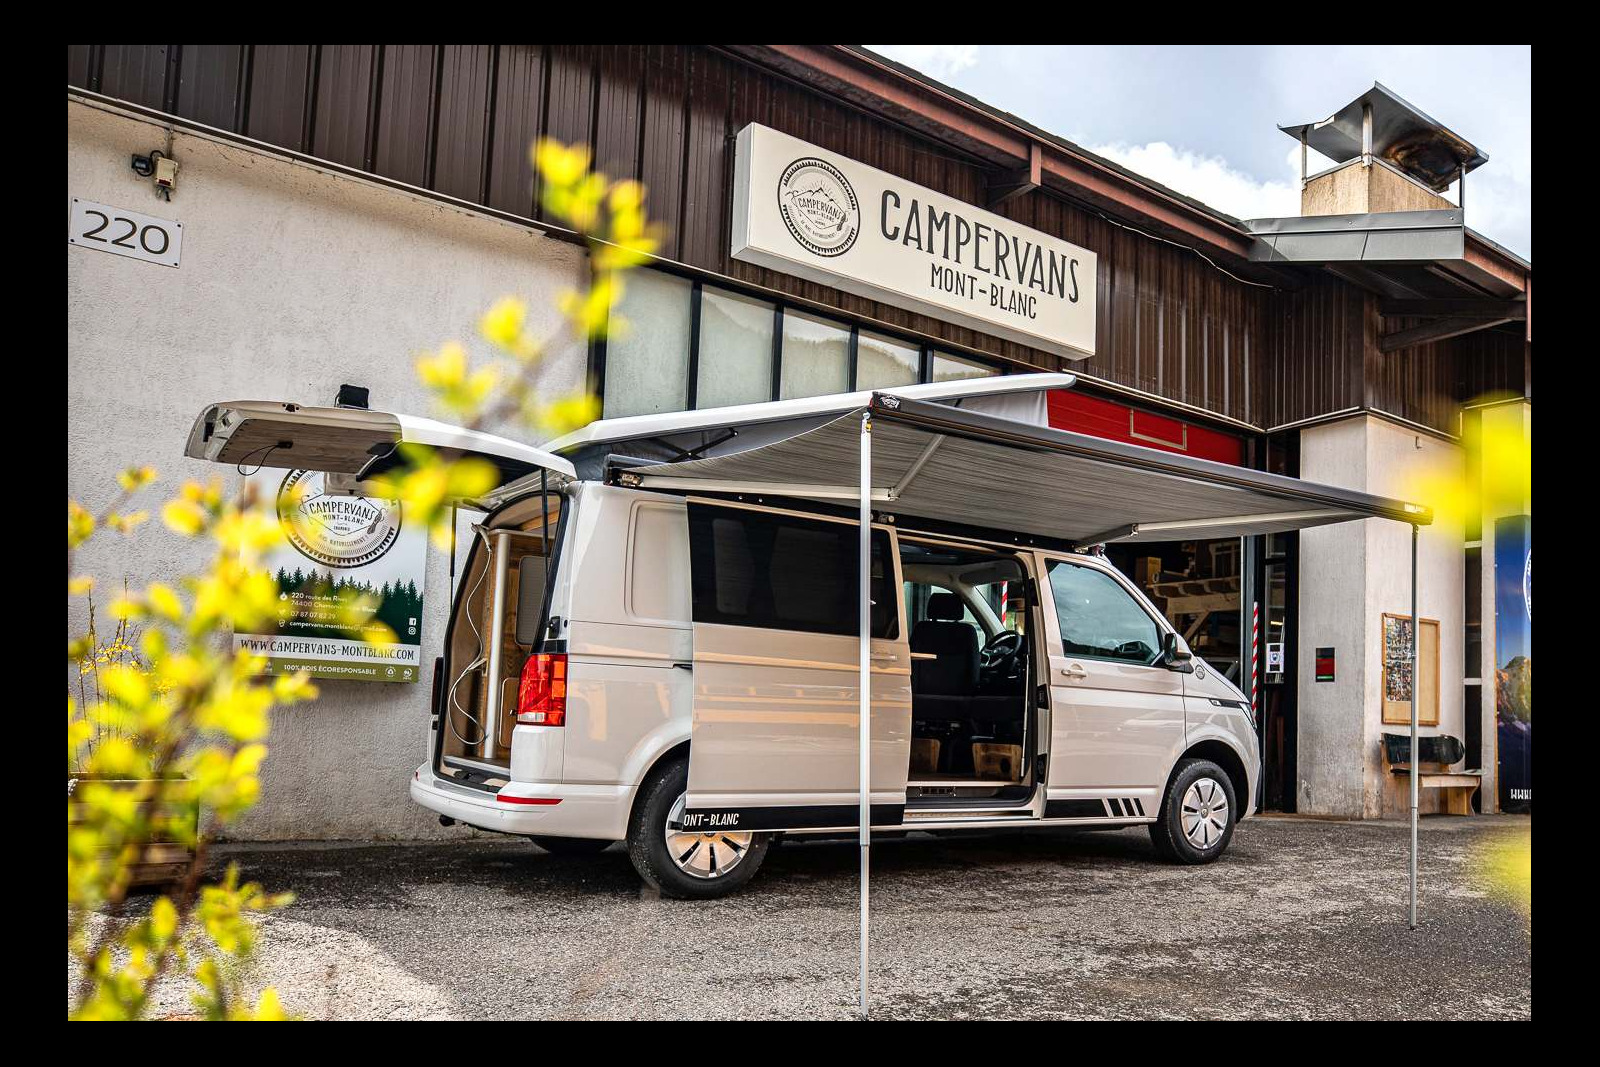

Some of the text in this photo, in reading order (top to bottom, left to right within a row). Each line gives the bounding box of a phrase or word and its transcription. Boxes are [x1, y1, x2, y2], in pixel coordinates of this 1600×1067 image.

[797, 198, 842, 220] CAMPERVANS
[82, 210, 170, 255] 220
[880, 189, 1080, 304] CAMPERVANS
[931, 263, 1037, 320] MONT-BLANC
[308, 501, 375, 521] CAMPERVANS
[322, 514, 365, 526] MONT-BLANC
[318, 664, 377, 675] ÉCORESPONSABLE
[683, 813, 740, 826] ONT-BLANC
